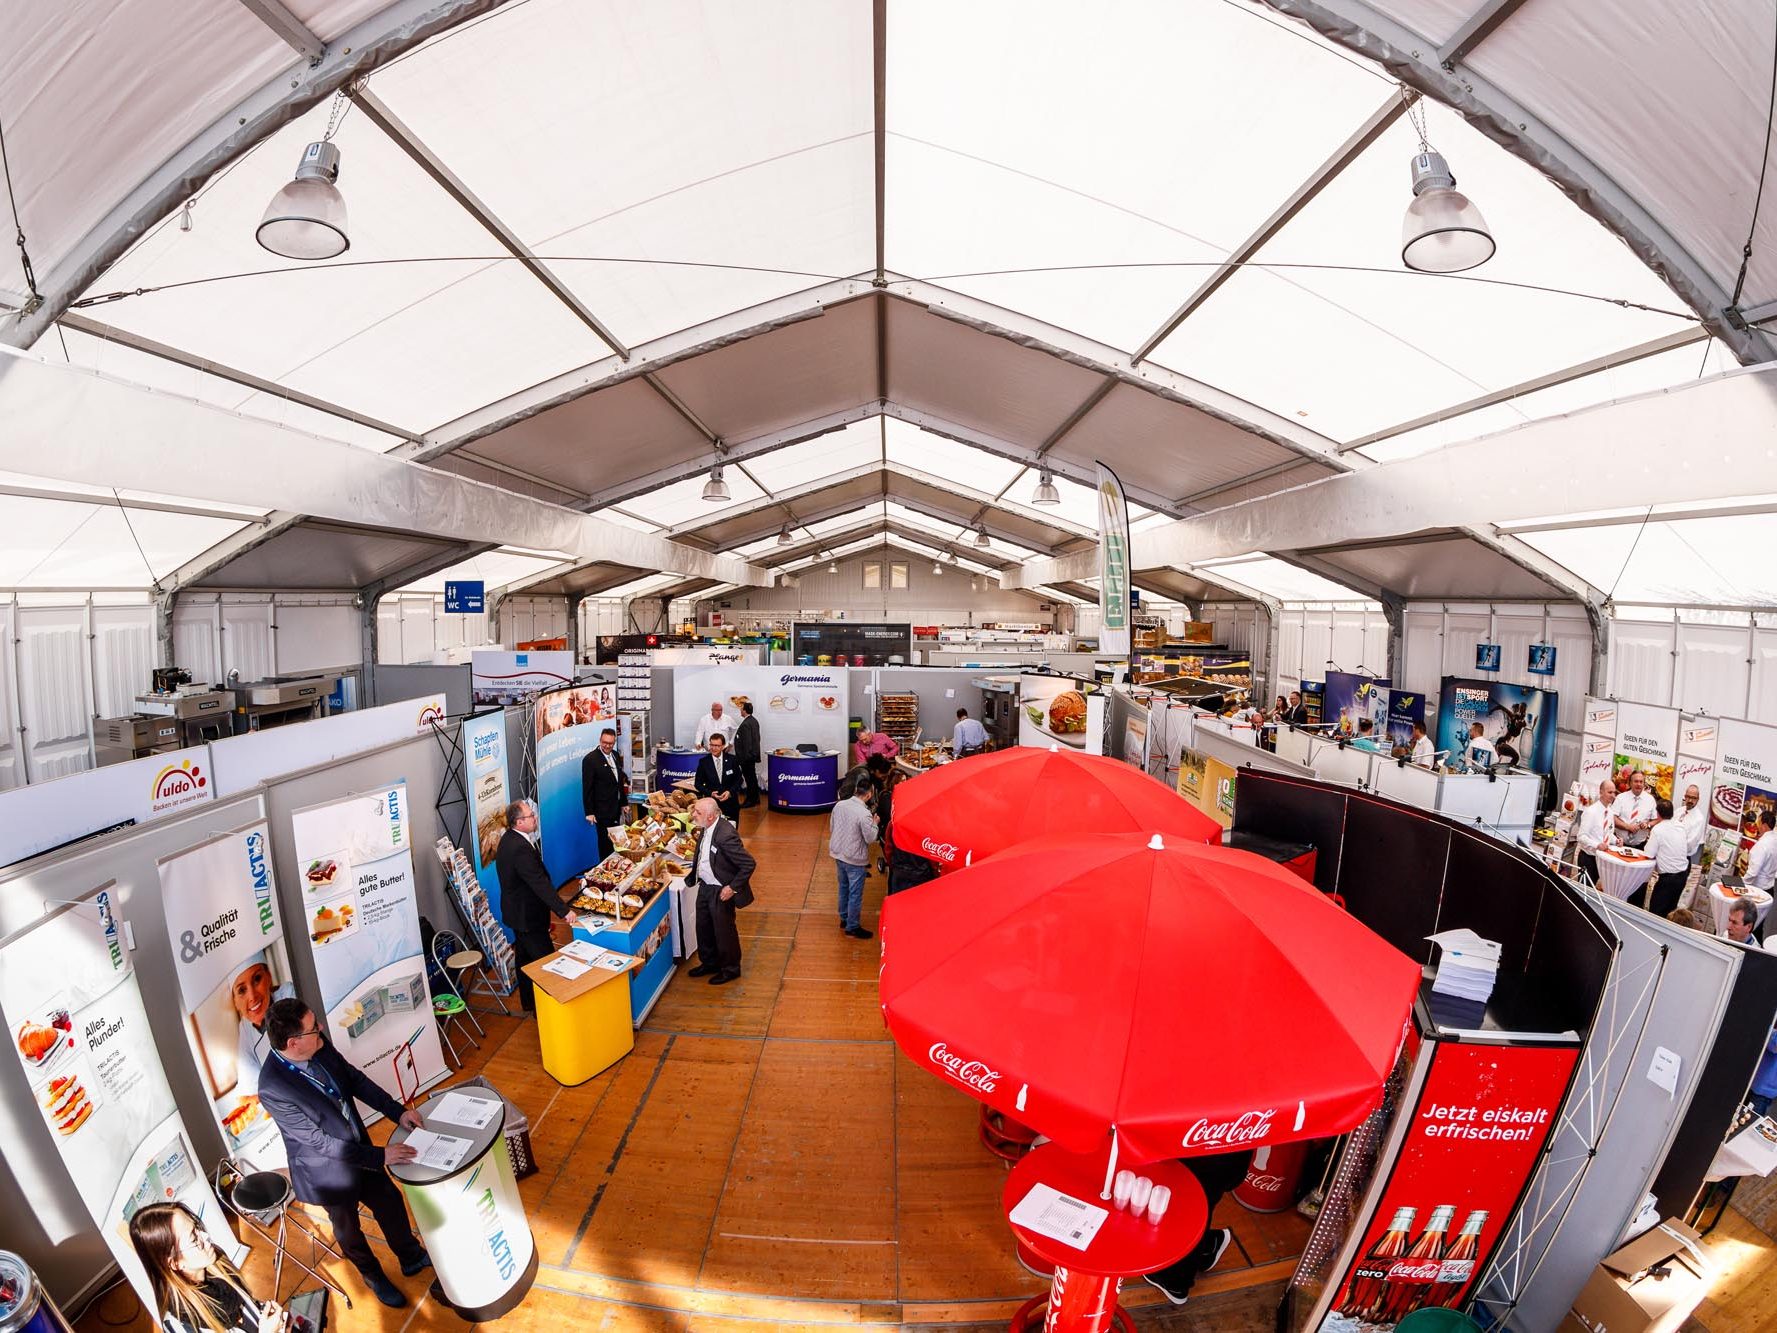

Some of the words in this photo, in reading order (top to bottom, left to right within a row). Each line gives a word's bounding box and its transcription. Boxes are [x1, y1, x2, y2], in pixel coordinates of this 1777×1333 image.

[447, 601, 460, 609] WC
[780, 674, 831, 686] Germania
[1456, 688, 1489, 697] ENSINGER
[1467, 694, 1489, 702] SPORT
[1639, 745, 1668, 758] GESCHMACK
[1648, 739, 1658, 747] DEN
[662, 768, 697, 778] Germania
[1750, 761, 1761, 771] DEN
[778, 772, 819, 783] Germania
[1740, 768, 1772, 784] GESCHMACK
[163, 780, 190, 797] uldo
[921, 836, 959, 861] Coca-Cola
[358, 873, 378, 886] Alles
[359, 883, 378, 897] gute
[379, 871, 405, 889] Butter!
[200, 908, 240, 938] Qualität
[180, 930, 203, 964] &
[203, 927, 237, 955] Frische
[85, 1016, 106, 1039] Alles
[88, 1016, 125, 1052] Plunder!
[928, 1042, 1003, 1093] Coca-Cola
[1422, 1103, 1478, 1122] Jetzt
[1482, 1106, 1549, 1124] eiskalt
[1181, 1108, 1280, 1148] Coca-Cola
[1424, 1123, 1534, 1141] erfrischen!
[1356, 1269, 1383, 1278] zero
[1384, 1261, 1441, 1281] Coca-Cola
